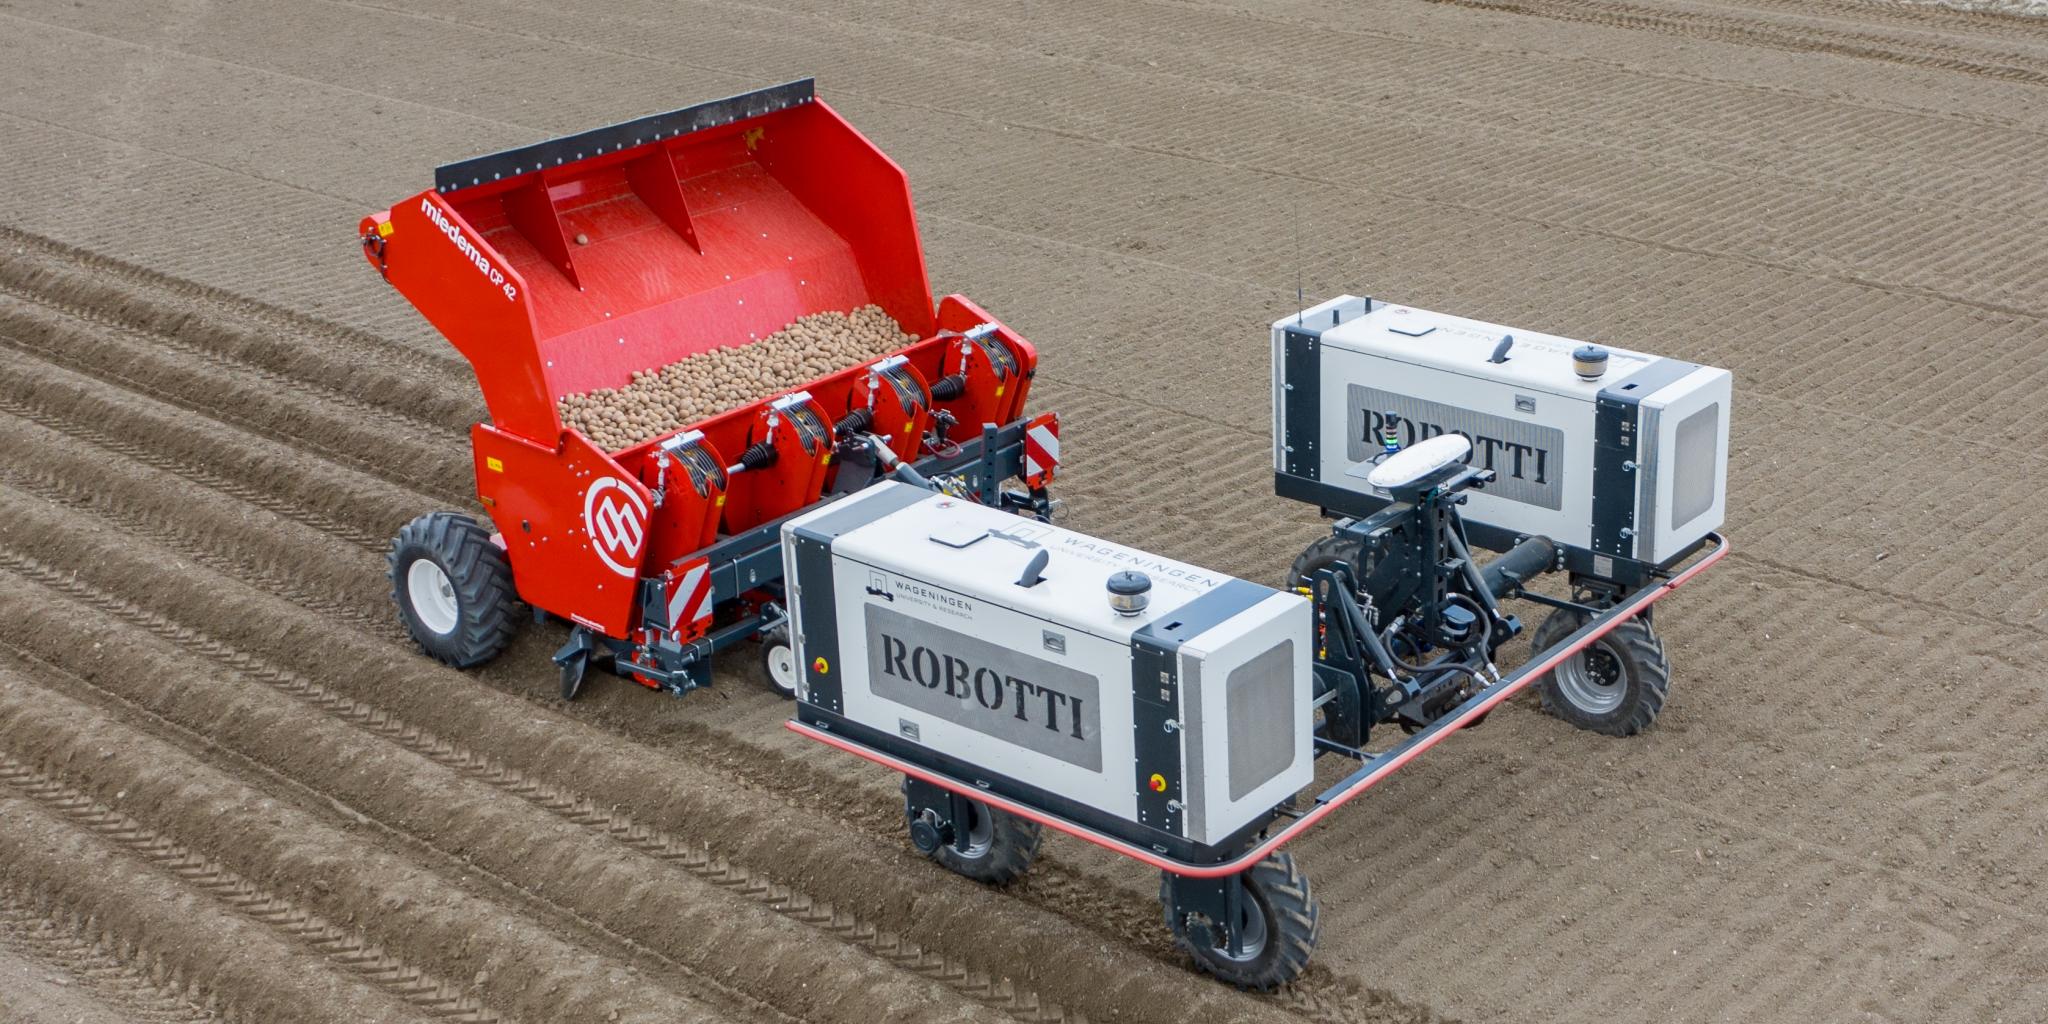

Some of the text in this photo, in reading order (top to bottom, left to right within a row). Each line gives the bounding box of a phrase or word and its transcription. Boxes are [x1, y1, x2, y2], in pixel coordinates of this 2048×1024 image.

[421, 198, 517, 302] miedema CP 42
[1064, 537, 1218, 588] WAGENINGEN
[895, 581, 973, 611] WAGENINGEN
[895, 592, 932, 607] UNIVERSITY
[938, 605, 974, 620] RESEARCH
[881, 633, 1084, 740] ROBOTTI
